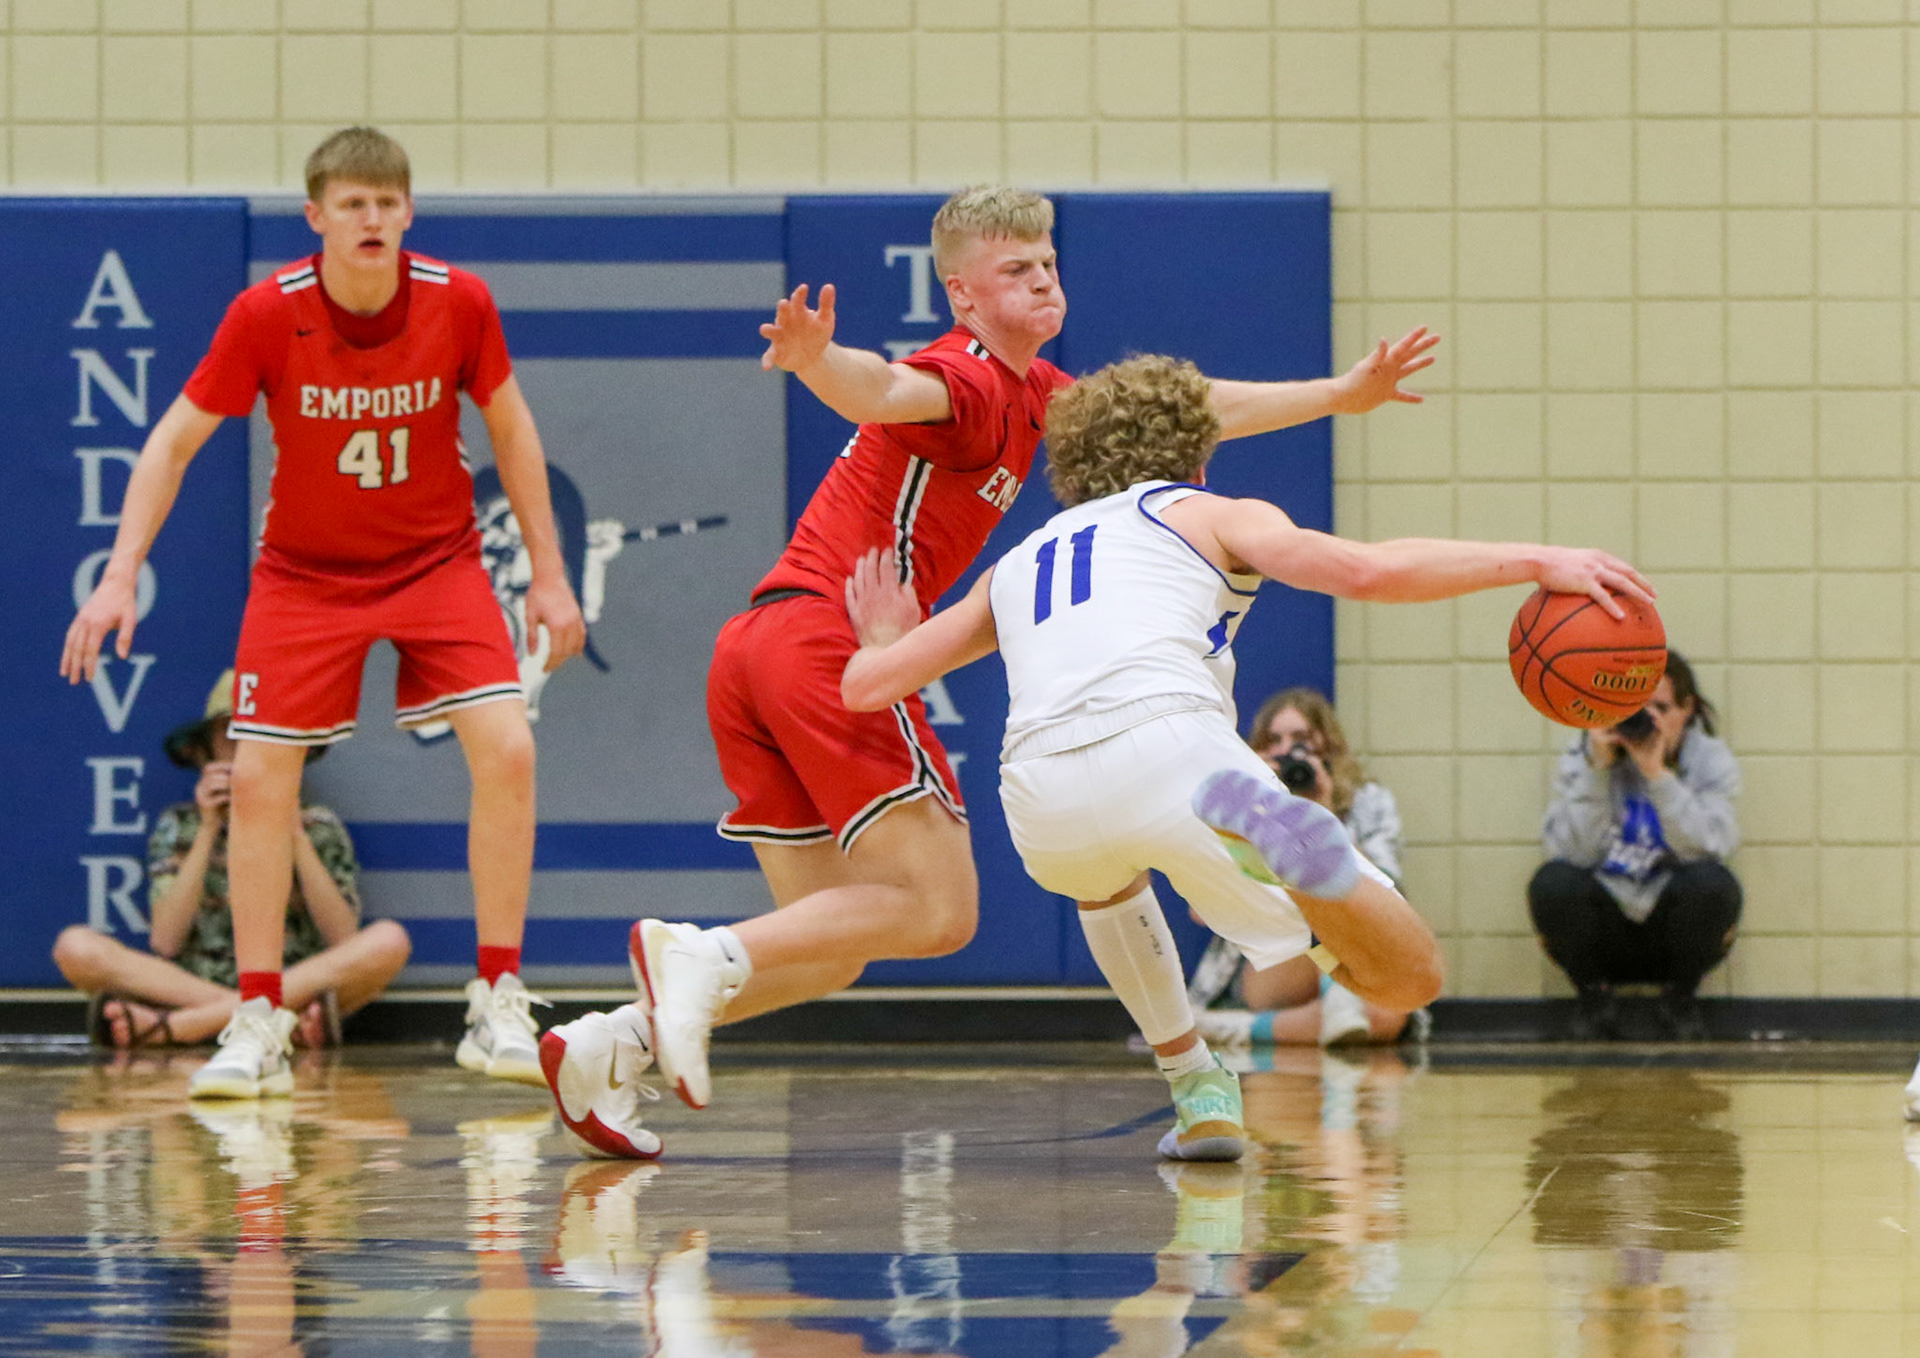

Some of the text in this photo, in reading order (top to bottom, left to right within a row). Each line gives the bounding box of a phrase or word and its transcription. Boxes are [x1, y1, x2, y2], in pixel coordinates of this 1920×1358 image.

[337, 426, 410, 488] 41
[1034, 524, 1098, 626] 11
[237, 672, 259, 716] E
